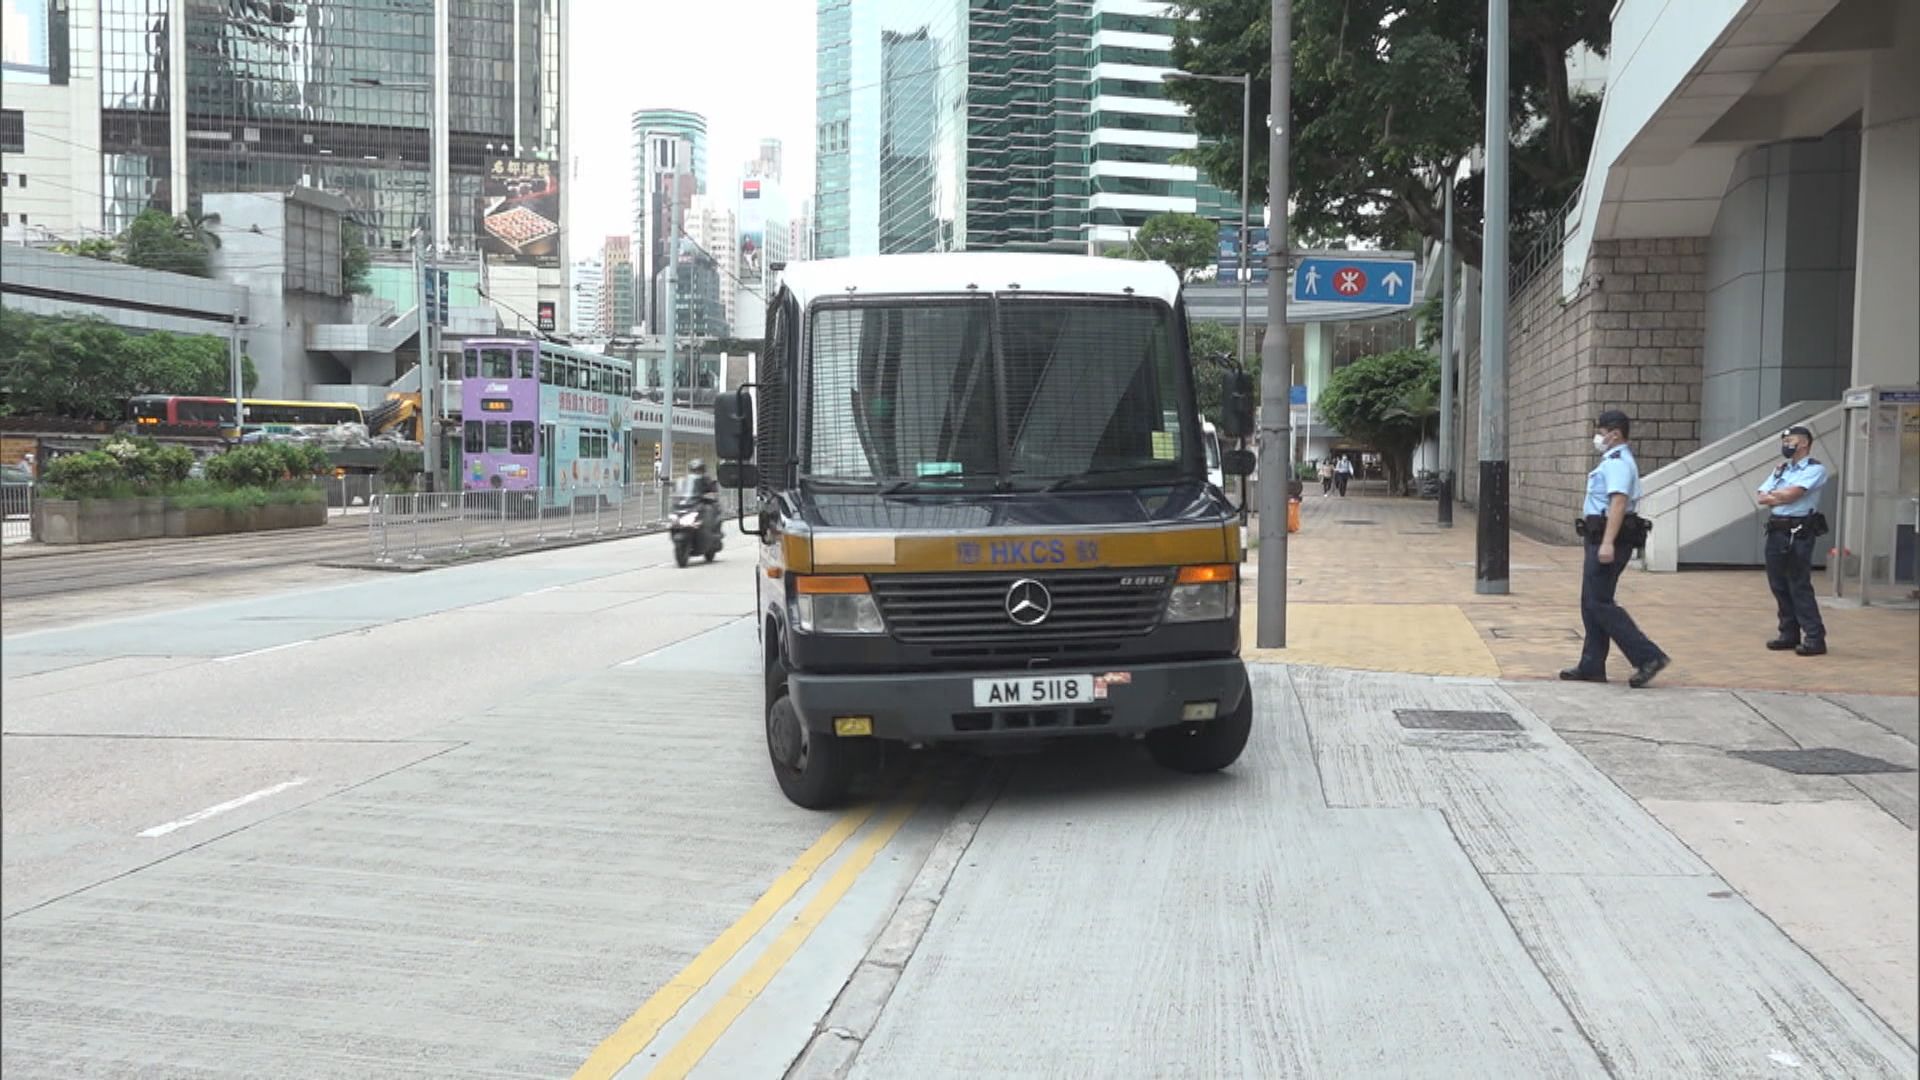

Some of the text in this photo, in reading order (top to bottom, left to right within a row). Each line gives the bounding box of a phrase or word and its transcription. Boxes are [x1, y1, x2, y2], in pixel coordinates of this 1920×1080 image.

[990, 540, 1066, 564] HKCS
[989, 683, 1021, 703] AM
[1032, 679, 1079, 701] 5118
